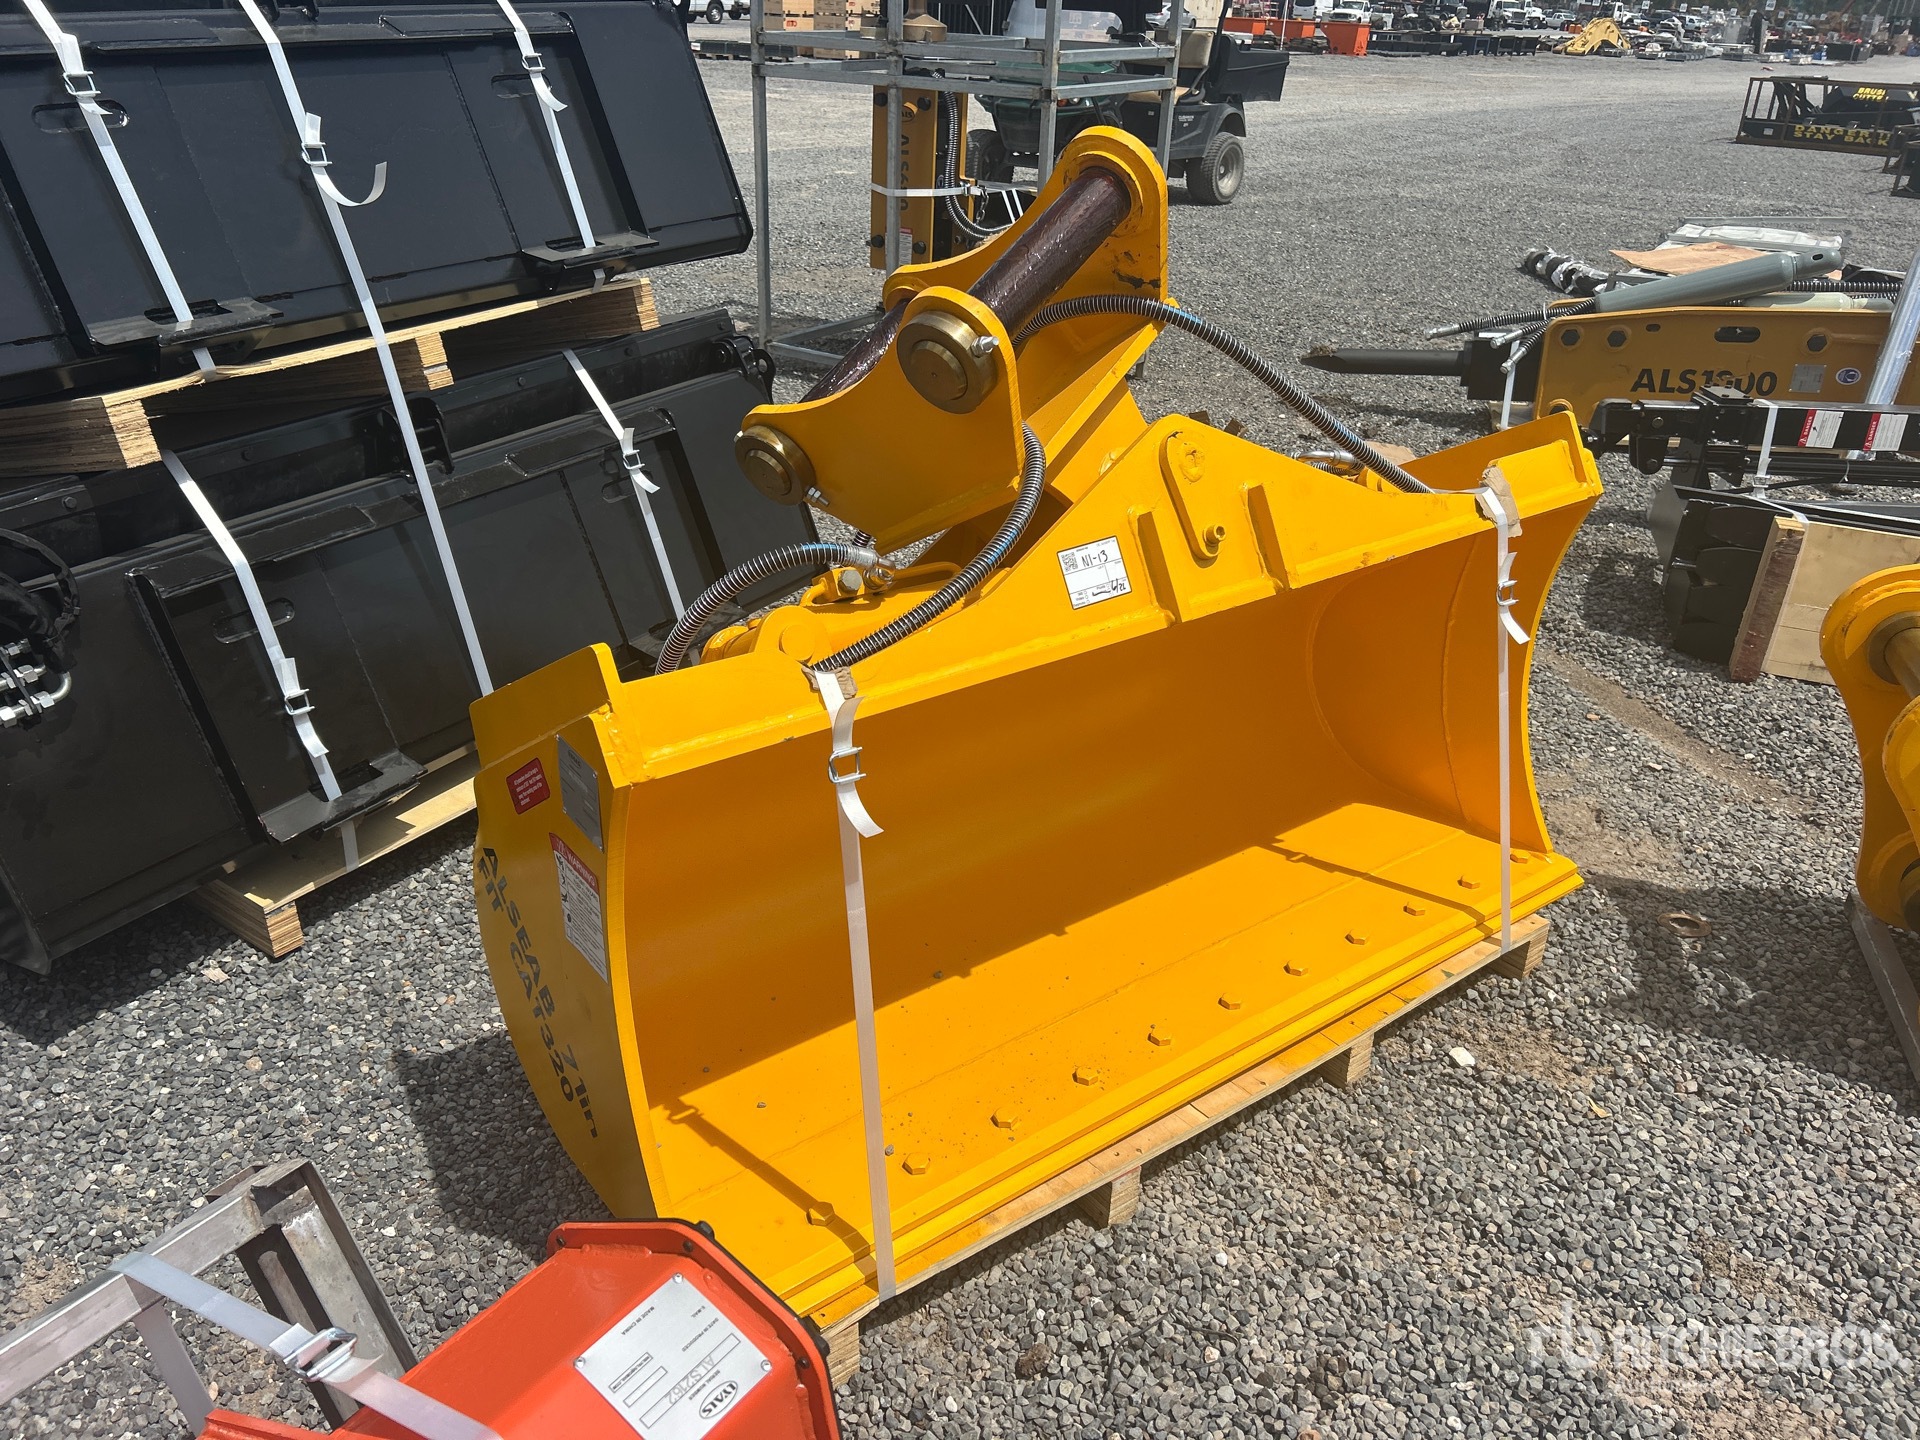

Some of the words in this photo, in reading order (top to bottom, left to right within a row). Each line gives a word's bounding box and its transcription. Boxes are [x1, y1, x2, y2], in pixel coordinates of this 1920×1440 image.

[1793, 131, 1835, 140] STAY
[1794, 125, 1870, 138] DANGER
[1803, 416, 1813, 436] DANGER
[483, 847, 555, 1017] ALSEAB
[476, 856, 504, 912] FIT
[510, 941, 574, 1102] CAT320
[668, 1354, 715, 1405] ALS2162
